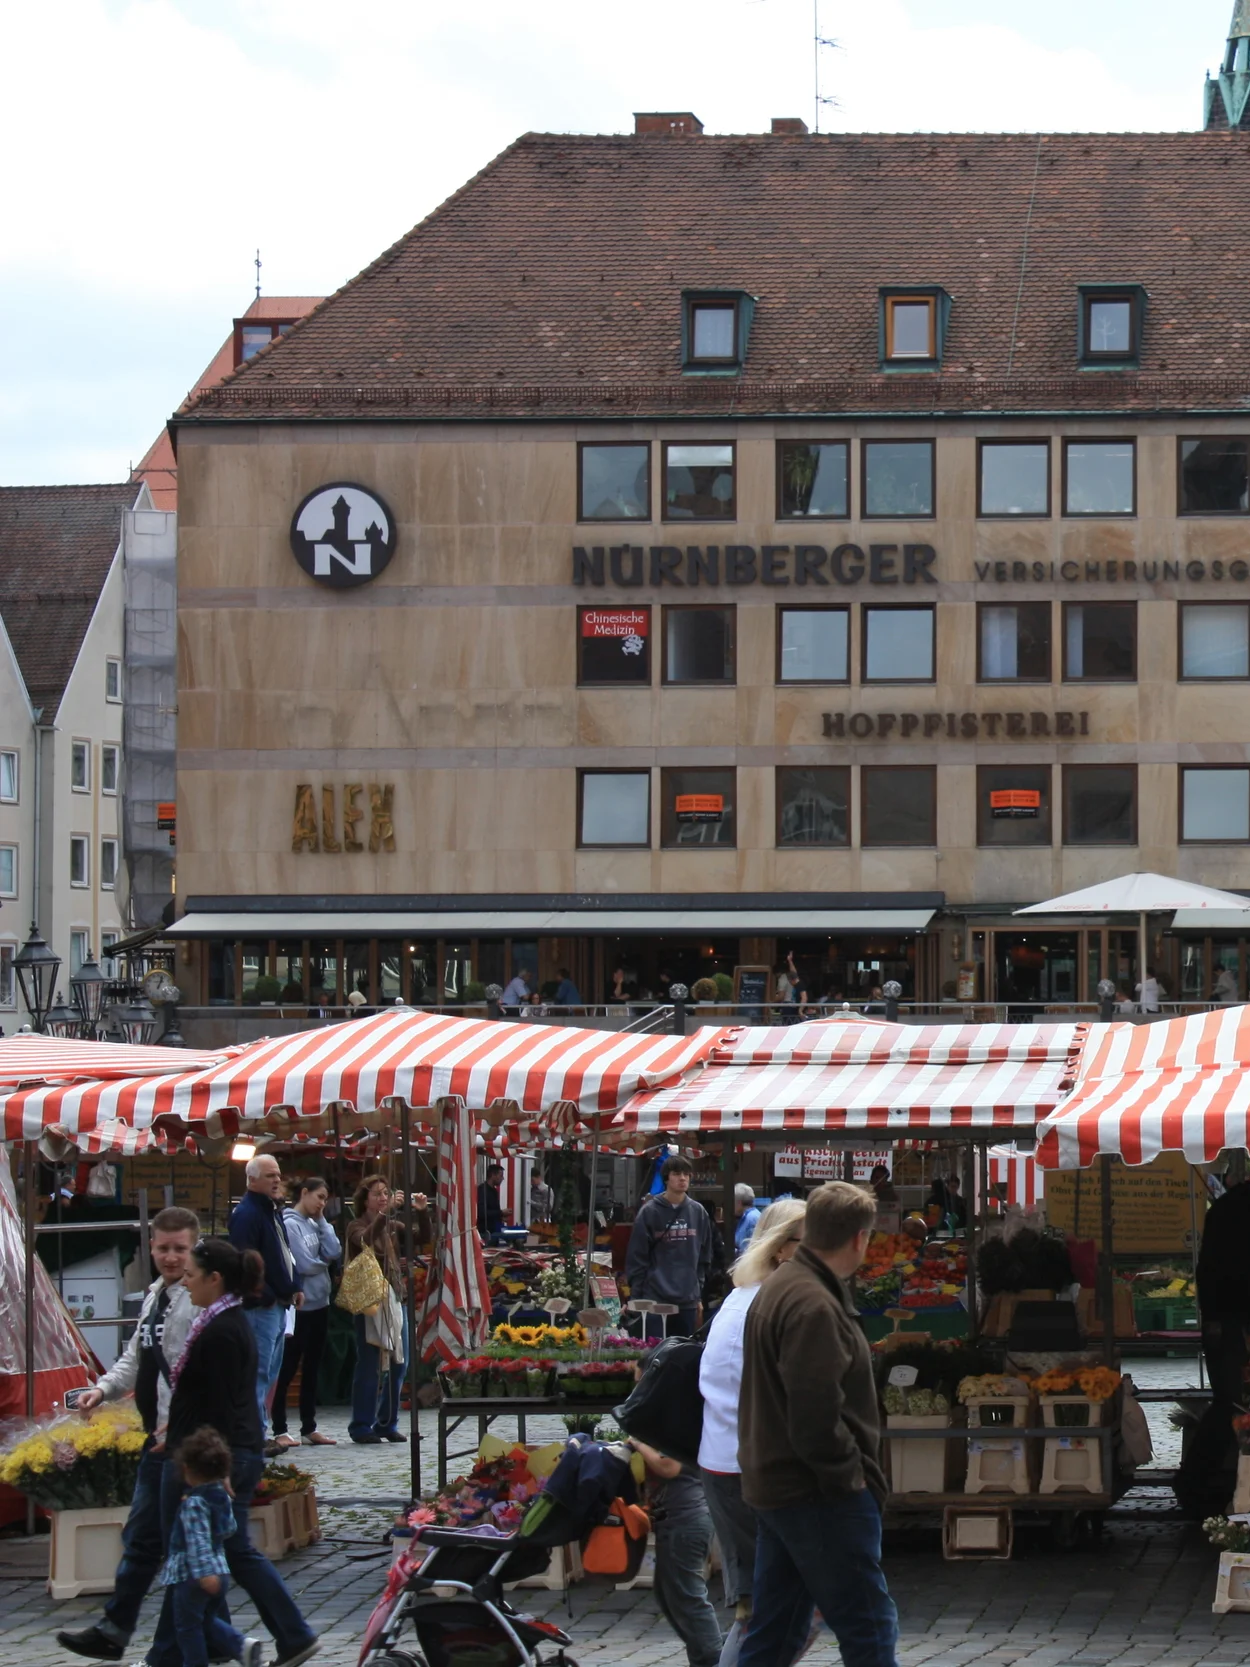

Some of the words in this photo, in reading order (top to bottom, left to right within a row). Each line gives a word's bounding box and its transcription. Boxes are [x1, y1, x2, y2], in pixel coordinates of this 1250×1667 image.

[314, 544, 371, 575] N
[572, 543, 939, 586] NÜRNBERGER
[585, 611, 644, 624] Chinesische
[594, 624, 635, 636] Medizin
[821, 711, 1090, 738] HOFPFISTEREI
[291, 784, 397, 853] ALEX
[778, 1156, 800, 1165] aus
[804, 1168, 833, 1176] igener
